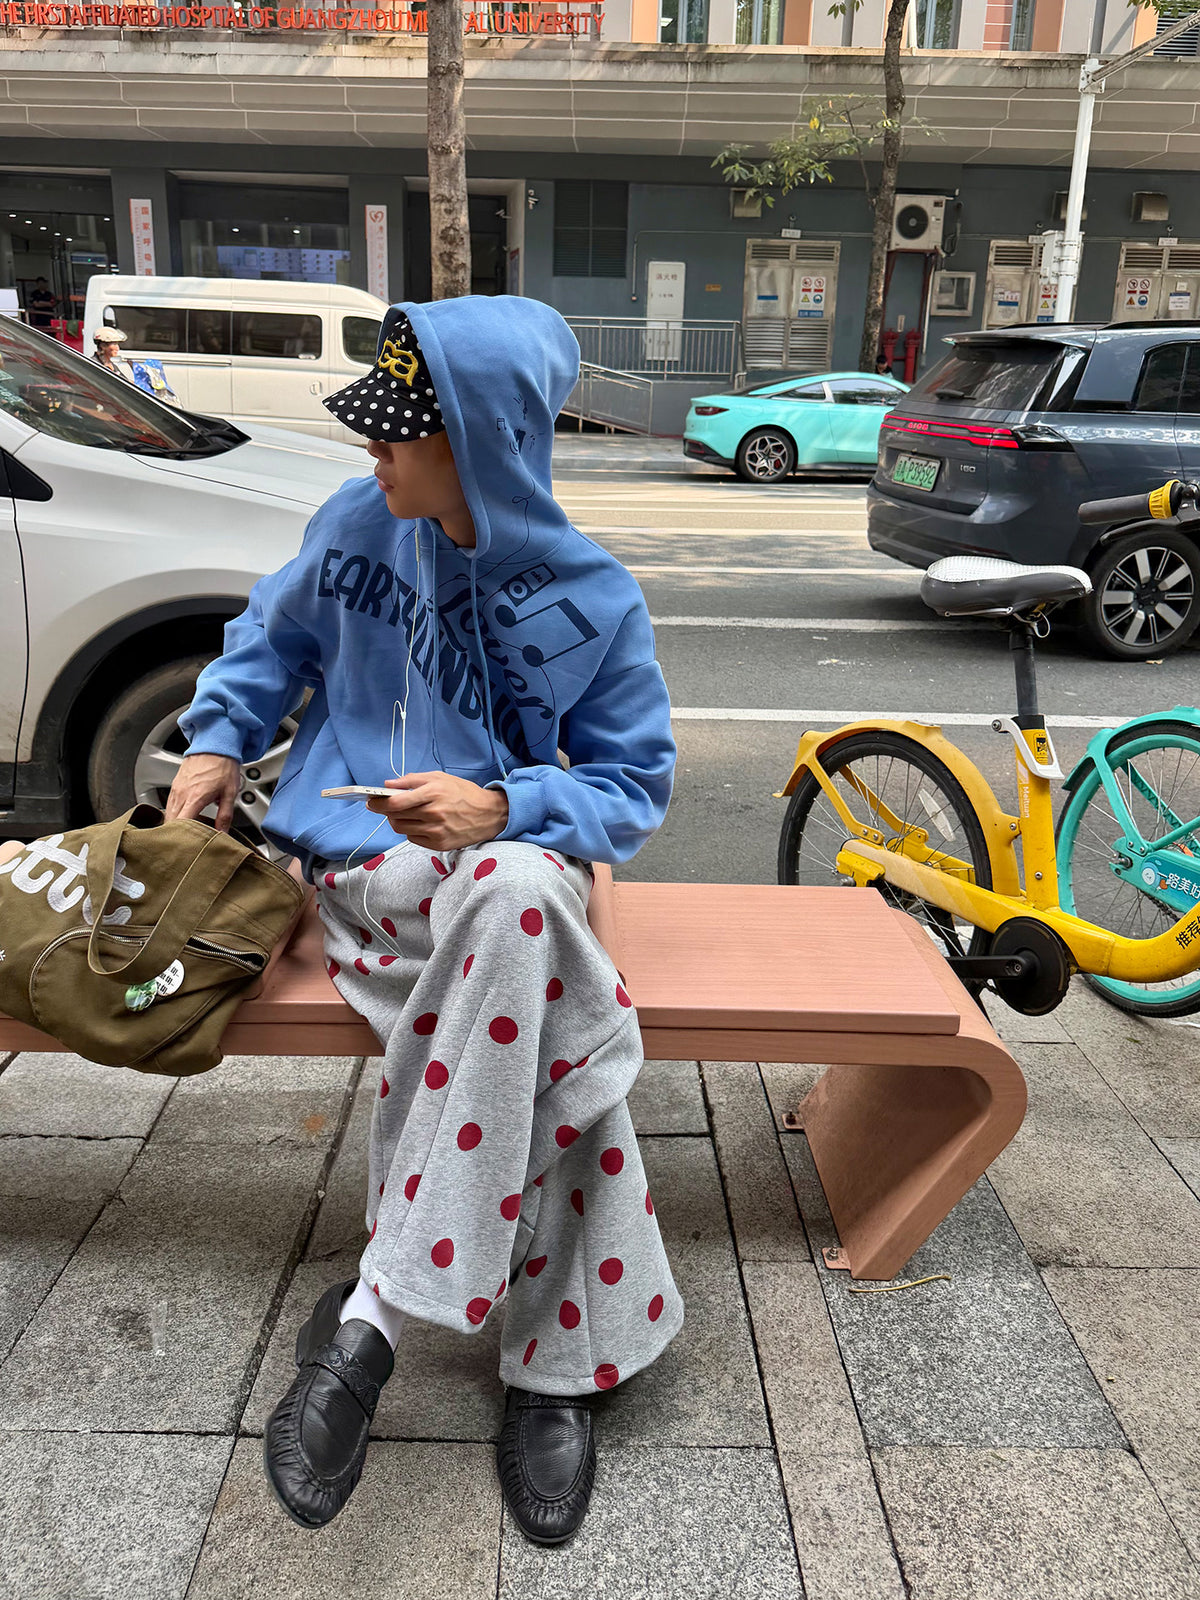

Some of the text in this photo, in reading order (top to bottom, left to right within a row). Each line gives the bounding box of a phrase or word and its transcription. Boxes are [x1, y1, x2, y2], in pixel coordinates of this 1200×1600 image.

[0, 3, 22, 24] HE
[25, 3, 70, 25] FIRST
[70, 5, 161, 26] AFFILIATED
[163, 6, 247, 28] HOSPITAL
[250, 7, 275, 28] OF
[277, 8, 402, 31] GUANGZHOU
[494, 11, 606, 34] UNIVERSITY
[1175, 915, 1200, 950] 推荐
